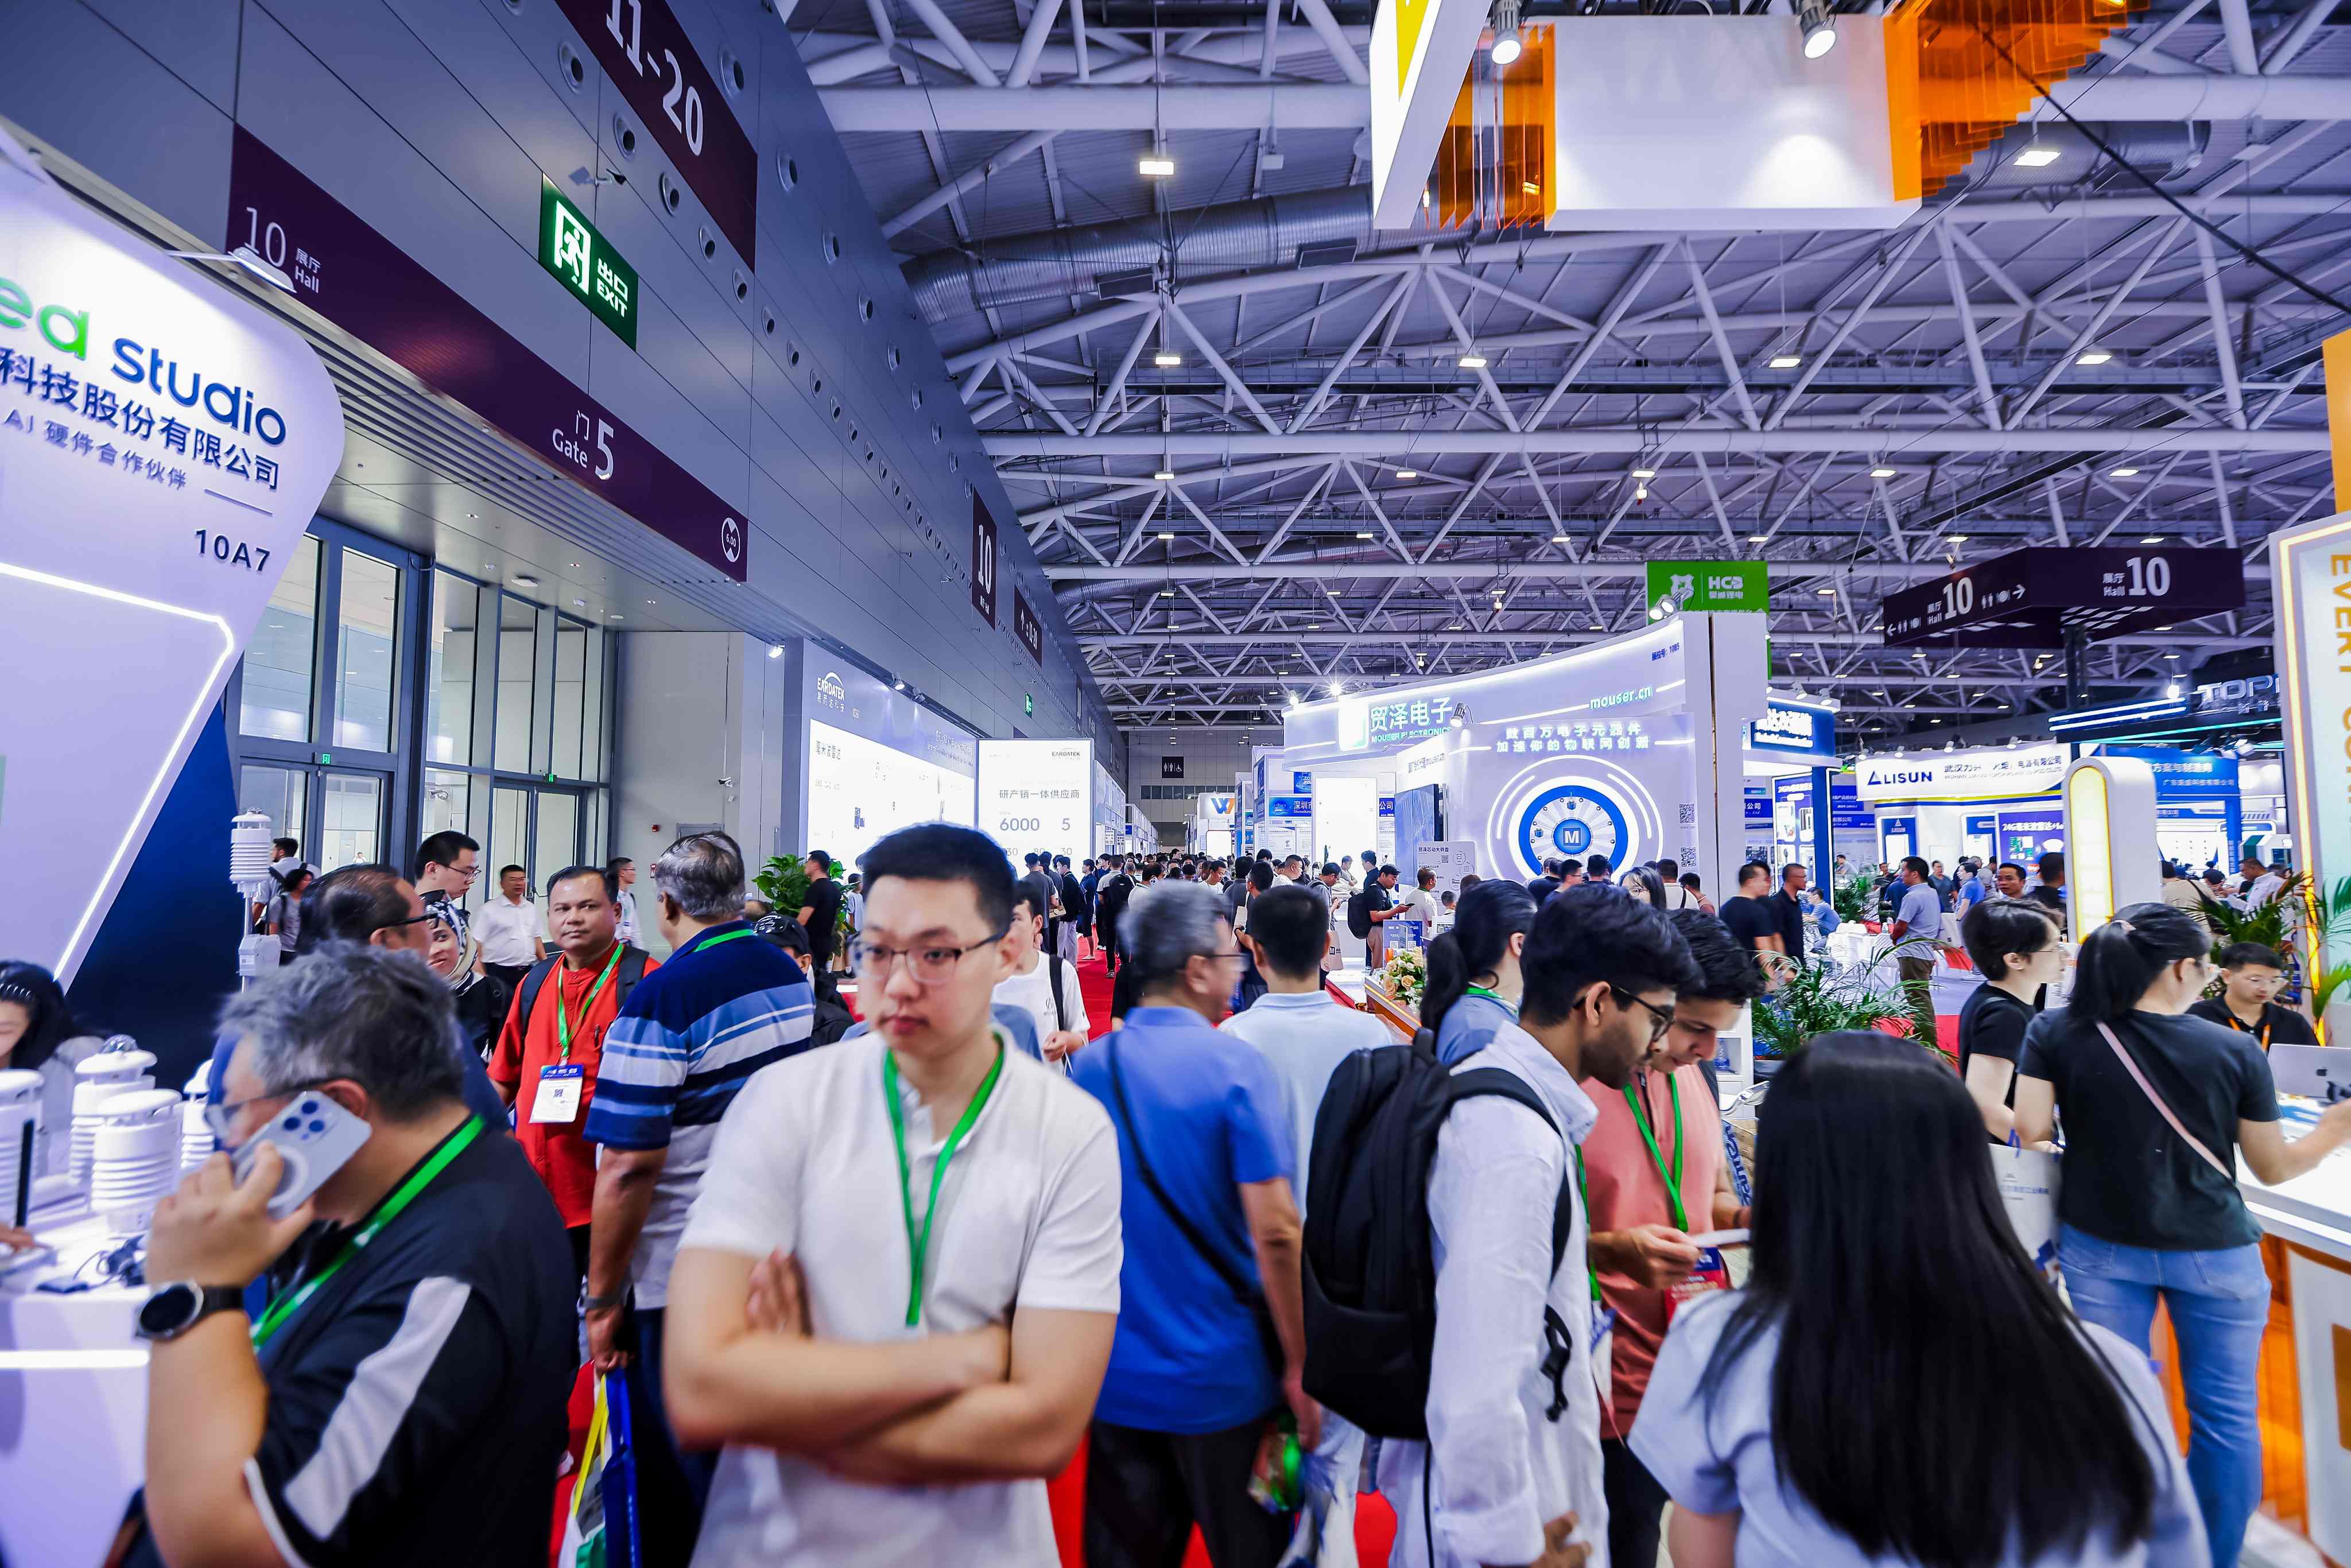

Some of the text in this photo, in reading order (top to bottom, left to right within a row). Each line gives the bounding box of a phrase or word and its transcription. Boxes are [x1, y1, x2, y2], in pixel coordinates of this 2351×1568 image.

[606, 0, 703, 156] 11-20
[244, 207, 286, 267] 10
[297, 247, 321, 273] 展厅
[295, 266, 319, 293] Hall
[597, 258, 628, 302] 出口
[597, 277, 627, 317] EXIT
[111, 337, 286, 447] studio
[576, 410, 590, 441] 门
[3, 409, 187, 491] AI 硬件合作伙伴
[552, 429, 588, 468] Gate
[595, 418, 614, 480] 5
[194, 529, 271, 572] 10A7
[726, 533, 736, 547] 6.00
[979, 525, 992, 594] 10
[2104, 585, 2125, 596] Hall
[2127, 557, 2170, 596] 10
[1943, 577, 1973, 620] 10
[1929, 612, 1942, 624] Hall
[1589, 685, 1654, 711] mouser.cn
[1370, 697, 1453, 733] 贸泽电子
[1371, 732, 1400, 743] MOUSER
[999, 789, 1080, 799] 研产销一体供应商
[1884, 771, 1932, 784] LISUN
[1379, 801, 1394, 810] 公司
[1000, 818, 1070, 831] 6000 5
[1564, 830, 1580, 844] M
